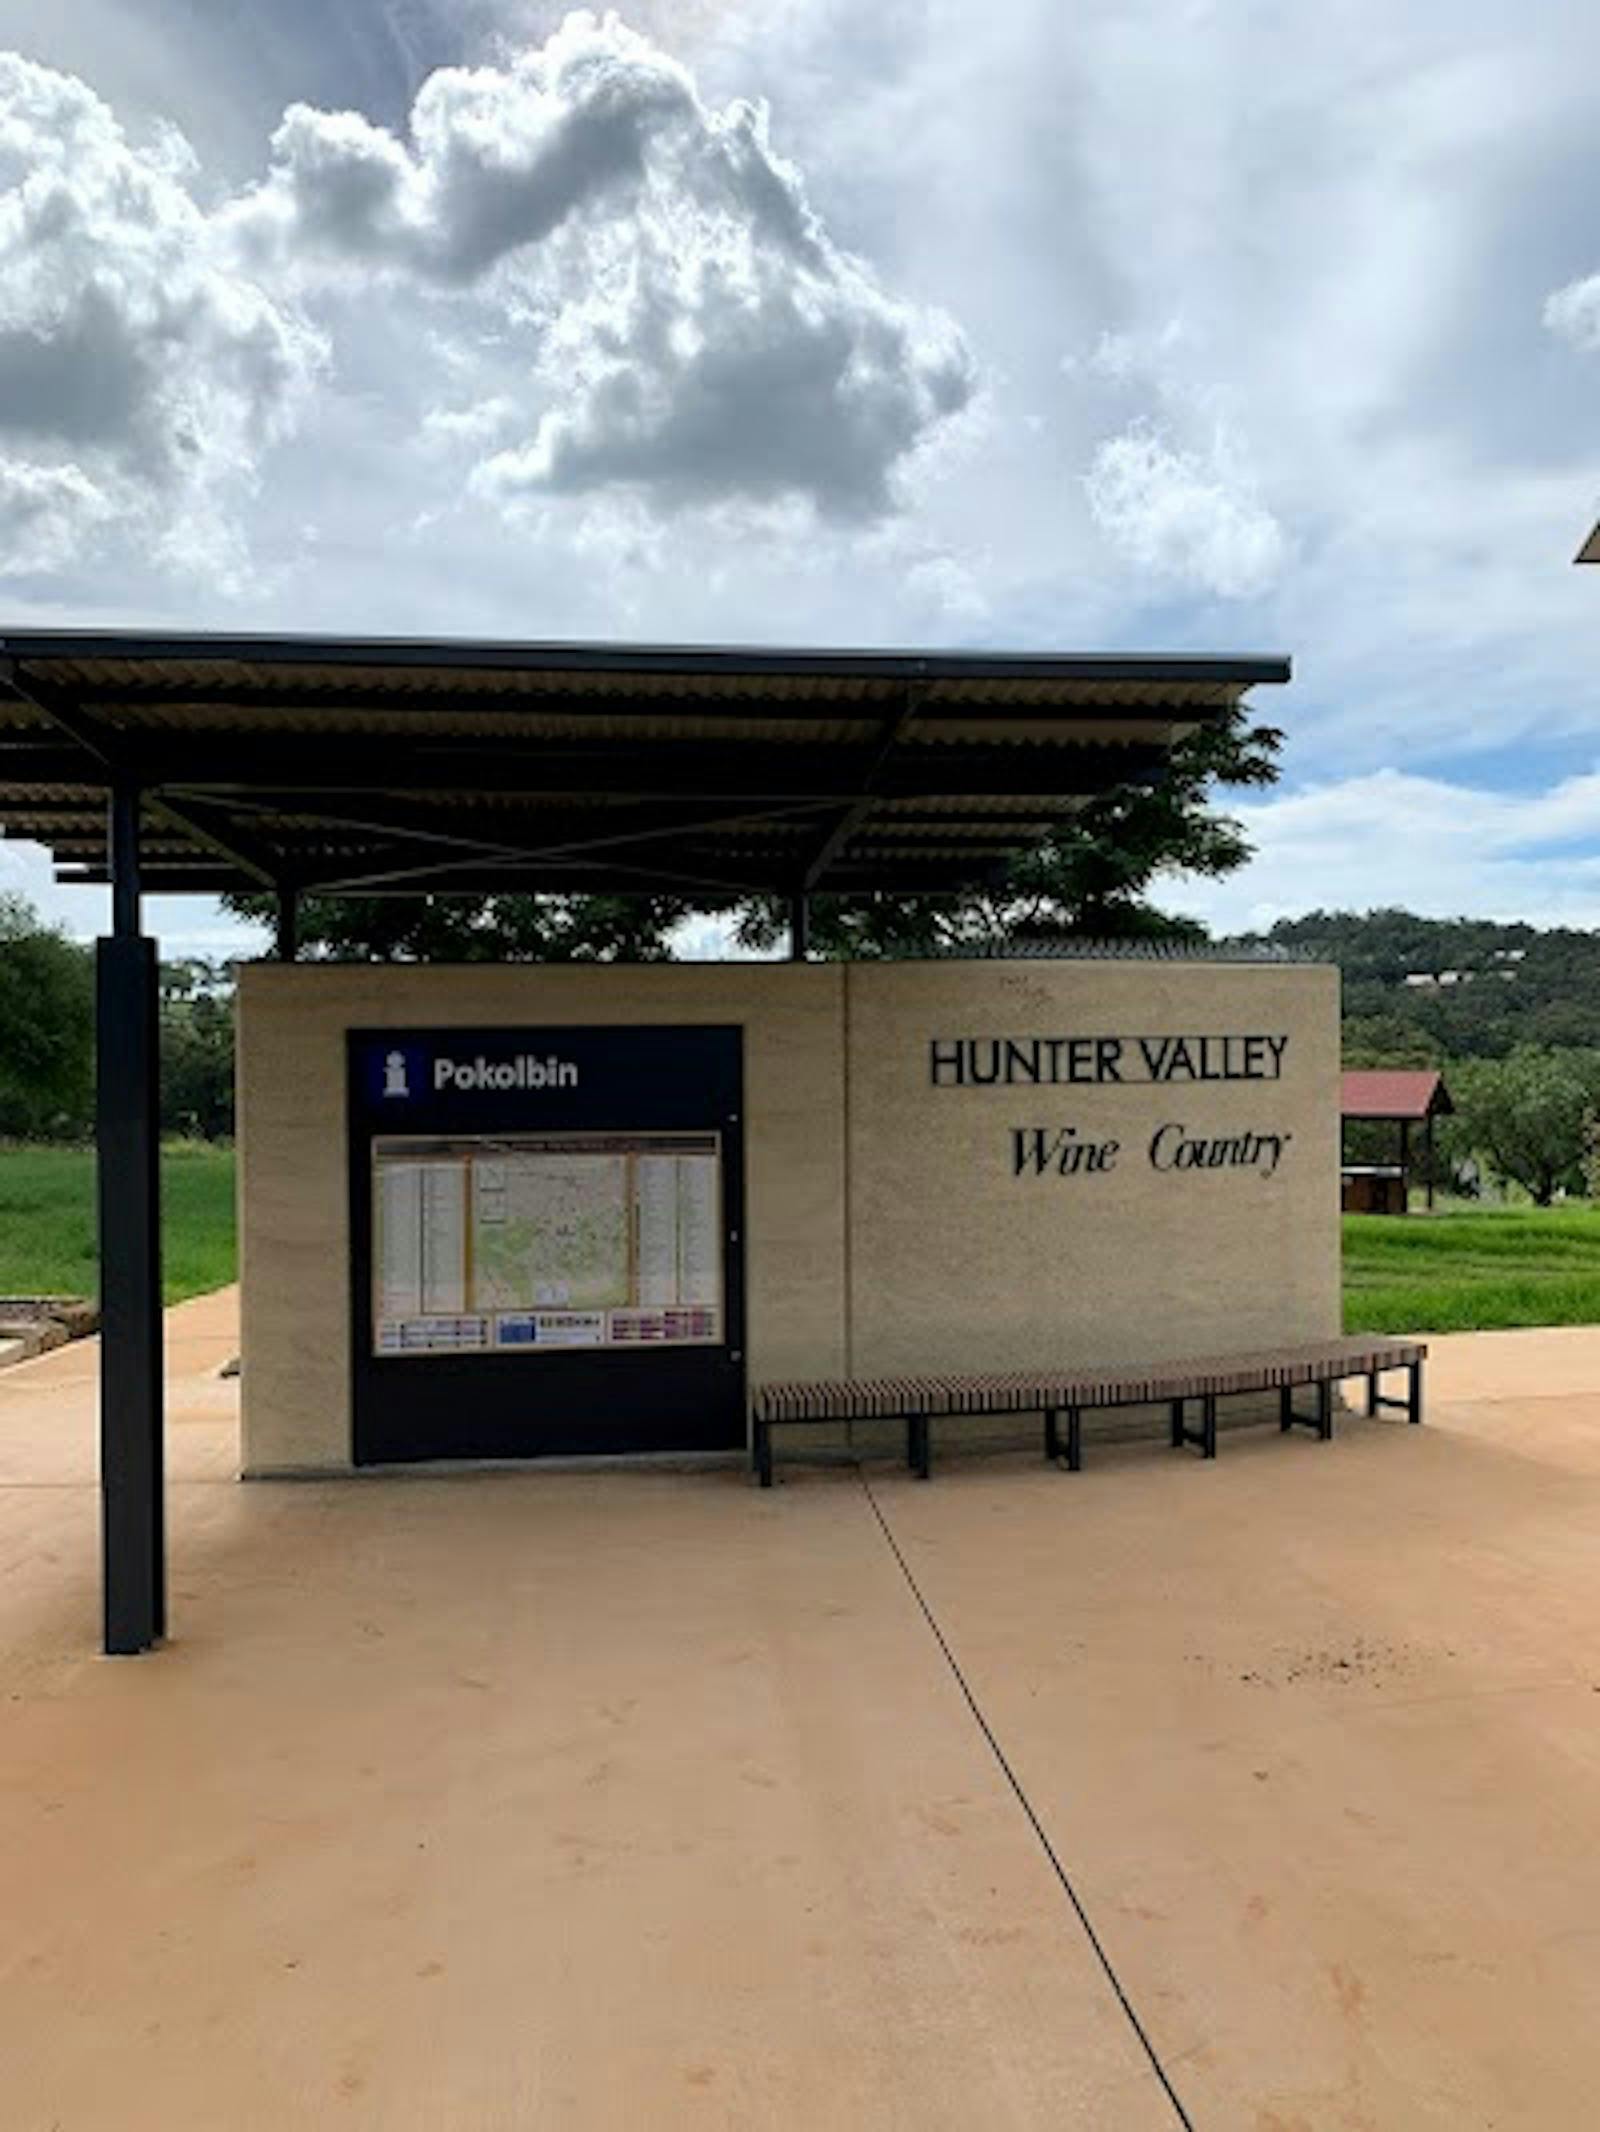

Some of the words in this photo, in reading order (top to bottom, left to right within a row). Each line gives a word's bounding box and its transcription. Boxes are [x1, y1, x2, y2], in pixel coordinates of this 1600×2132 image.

[434, 1055, 578, 1090] Pokolbin
[931, 1038, 1122, 1084] HUNTER
[1140, 1035, 1287, 1080] VALLEY
[1009, 1127, 1119, 1176] Wine
[1149, 1123, 1291, 1179] Country
